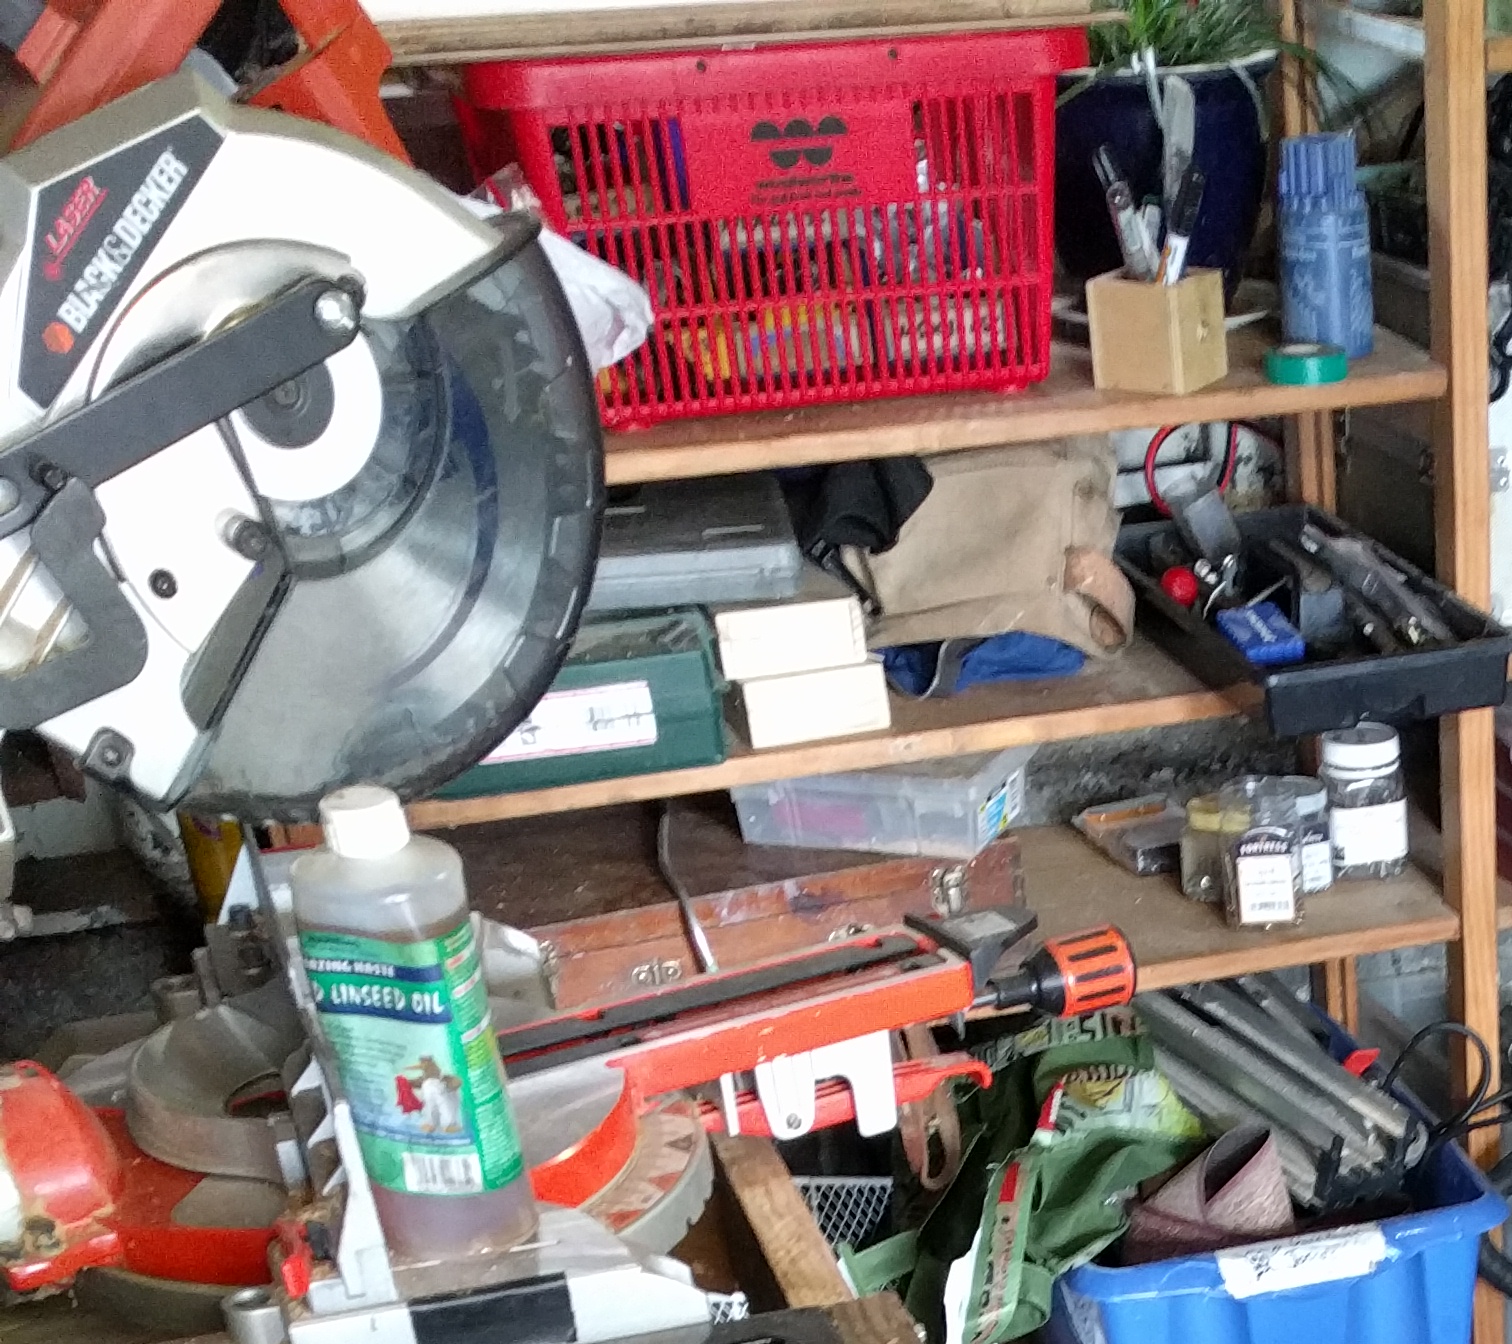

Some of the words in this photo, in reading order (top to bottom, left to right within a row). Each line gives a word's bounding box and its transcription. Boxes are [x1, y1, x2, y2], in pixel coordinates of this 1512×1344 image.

[44, 175, 101, 254] LASER
[56, 149, 189, 334] BLACK&DECKER
[331, 982, 406, 1011] LINSEED
[411, 990, 445, 1015] OIL
